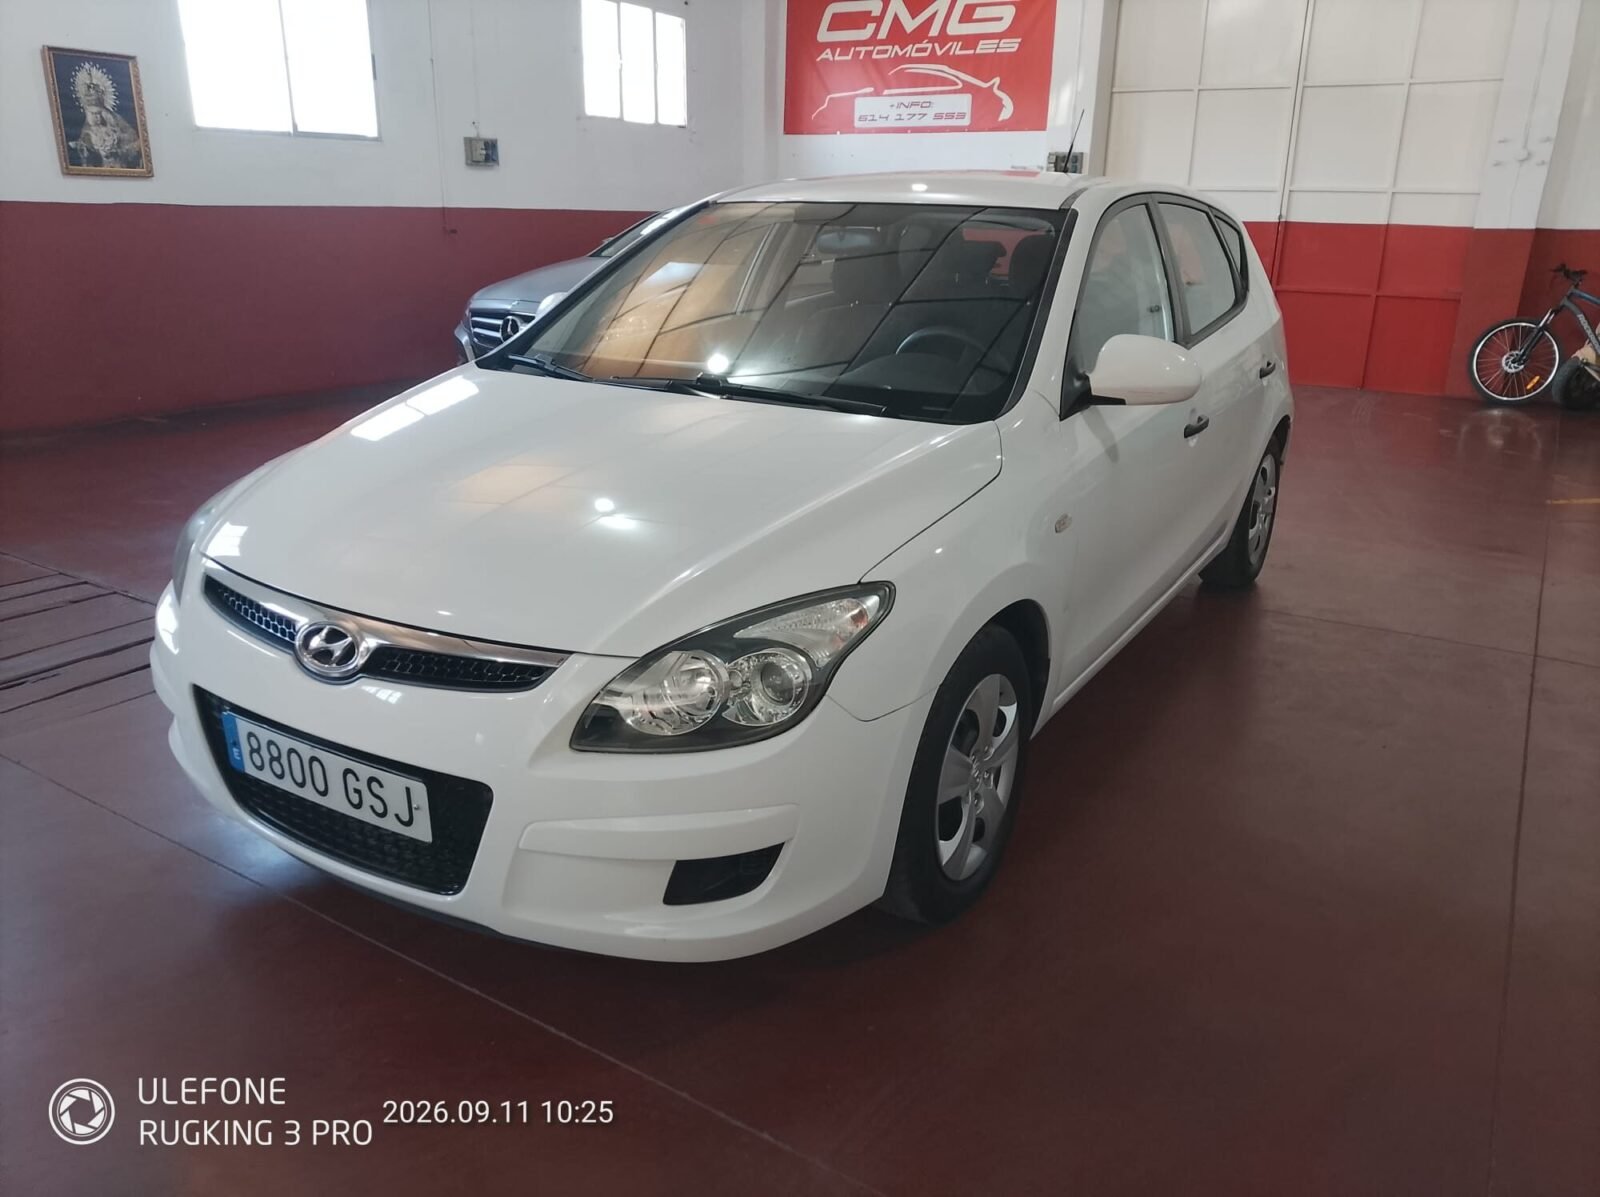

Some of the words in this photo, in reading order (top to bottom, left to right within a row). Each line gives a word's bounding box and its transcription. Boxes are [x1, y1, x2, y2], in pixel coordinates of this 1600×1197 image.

[817, 0, 1020, 43] CMG
[816, 38, 1022, 61] AUTOMÓVILES
[858, 114, 889, 122] 614
[894, 113, 928, 121] 177
[932, 112, 967, 120] 553
[232, 747, 241, 760] E
[246, 731, 329, 798] 8800
[342, 767, 414, 828] GSJ
